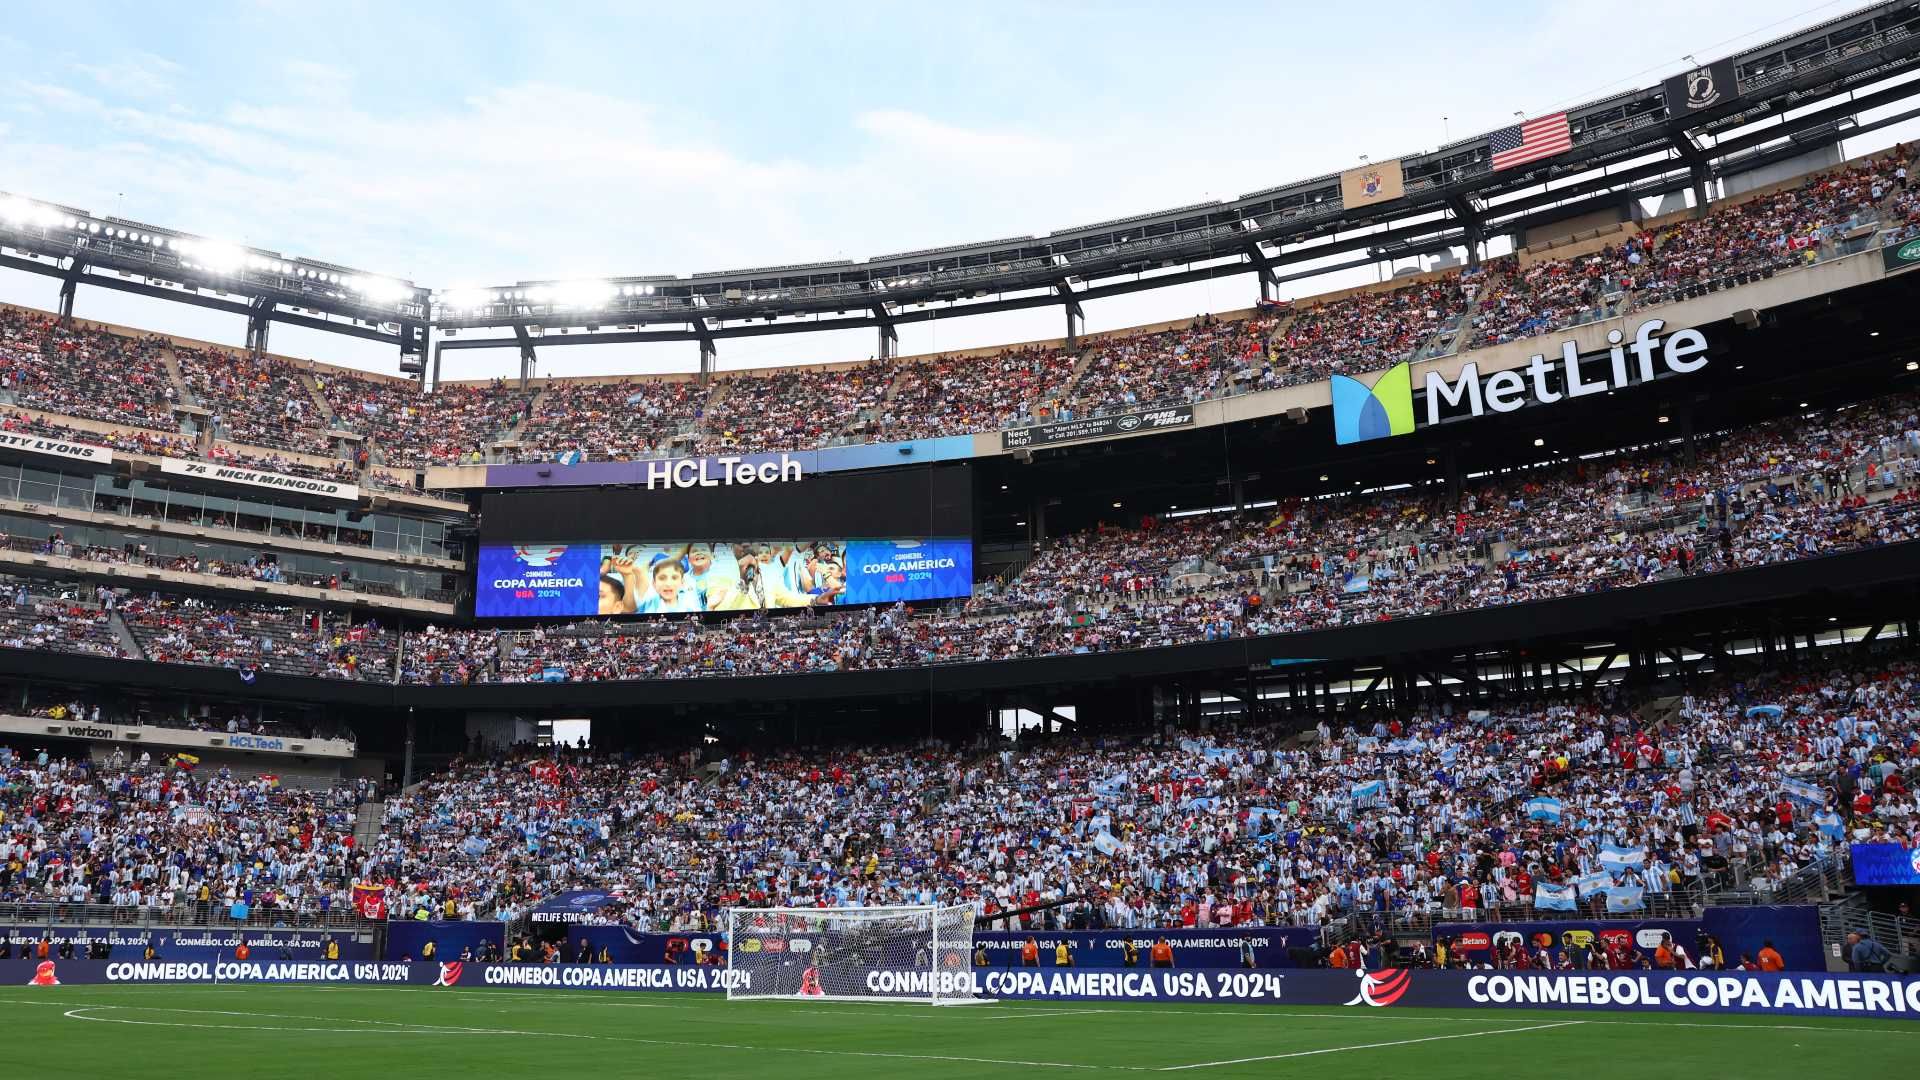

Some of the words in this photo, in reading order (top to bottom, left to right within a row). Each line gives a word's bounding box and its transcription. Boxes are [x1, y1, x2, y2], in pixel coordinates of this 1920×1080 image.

[1426, 319, 1710, 426] MetLife
[1143, 410, 1177, 421] FANS
[1153, 415, 1192, 426] FIRST
[1007, 429, 1029, 438] Need
[1008, 436, 1032, 446] Help?
[35, 441, 94, 457] LYONS
[648, 454, 802, 490] HCLTech
[215, 468, 255, 481] NICK
[258, 475, 338, 493] MANGOLD
[863, 563, 896, 574] COPA
[898, 558, 955, 571] AMERICA
[908, 572, 932, 581] 2024
[494, 579, 527, 589] COPA
[528, 578, 584, 588] AMERICA
[537, 589, 561, 598] 2024
[67, 725, 113, 739] verizon
[229, 735, 283, 750] HCLTech
[532, 912, 561, 922] METLIFE
[109, 936, 126, 946] USA
[127, 937, 148, 946] 2024
[175, 938, 222, 946] CONMEBOL
[247, 939, 284, 947] AMERICA
[301, 940, 321, 948] 2024
[1040, 941, 1056, 950] USA
[1183, 938, 1227, 948] AMERICA
[106, 962, 212, 980] CONMEBOL
[216, 963, 263, 980] COPA
[265, 963, 349, 980] AMERICA
[354, 963, 380, 981] USA
[382, 964, 409, 981] 2024
[485, 966, 560, 985] CONMEBOL
[562, 967, 601, 986] COPA
[603, 968, 672, 987] AMERICA
[677, 968, 708, 989] USA
[711, 968, 751, 989] 2024
[867, 970, 984, 994] CONMEBOL
[985, 971, 1047, 995] COPA
[1048, 972, 1158, 997] AMERICA
[1163, 972, 1213, 998] USA
[1217, 973, 1281, 998] 2024
[1467, 975, 1661, 1005] CONMEBOL
[1664, 976, 1771, 1008] COPA
